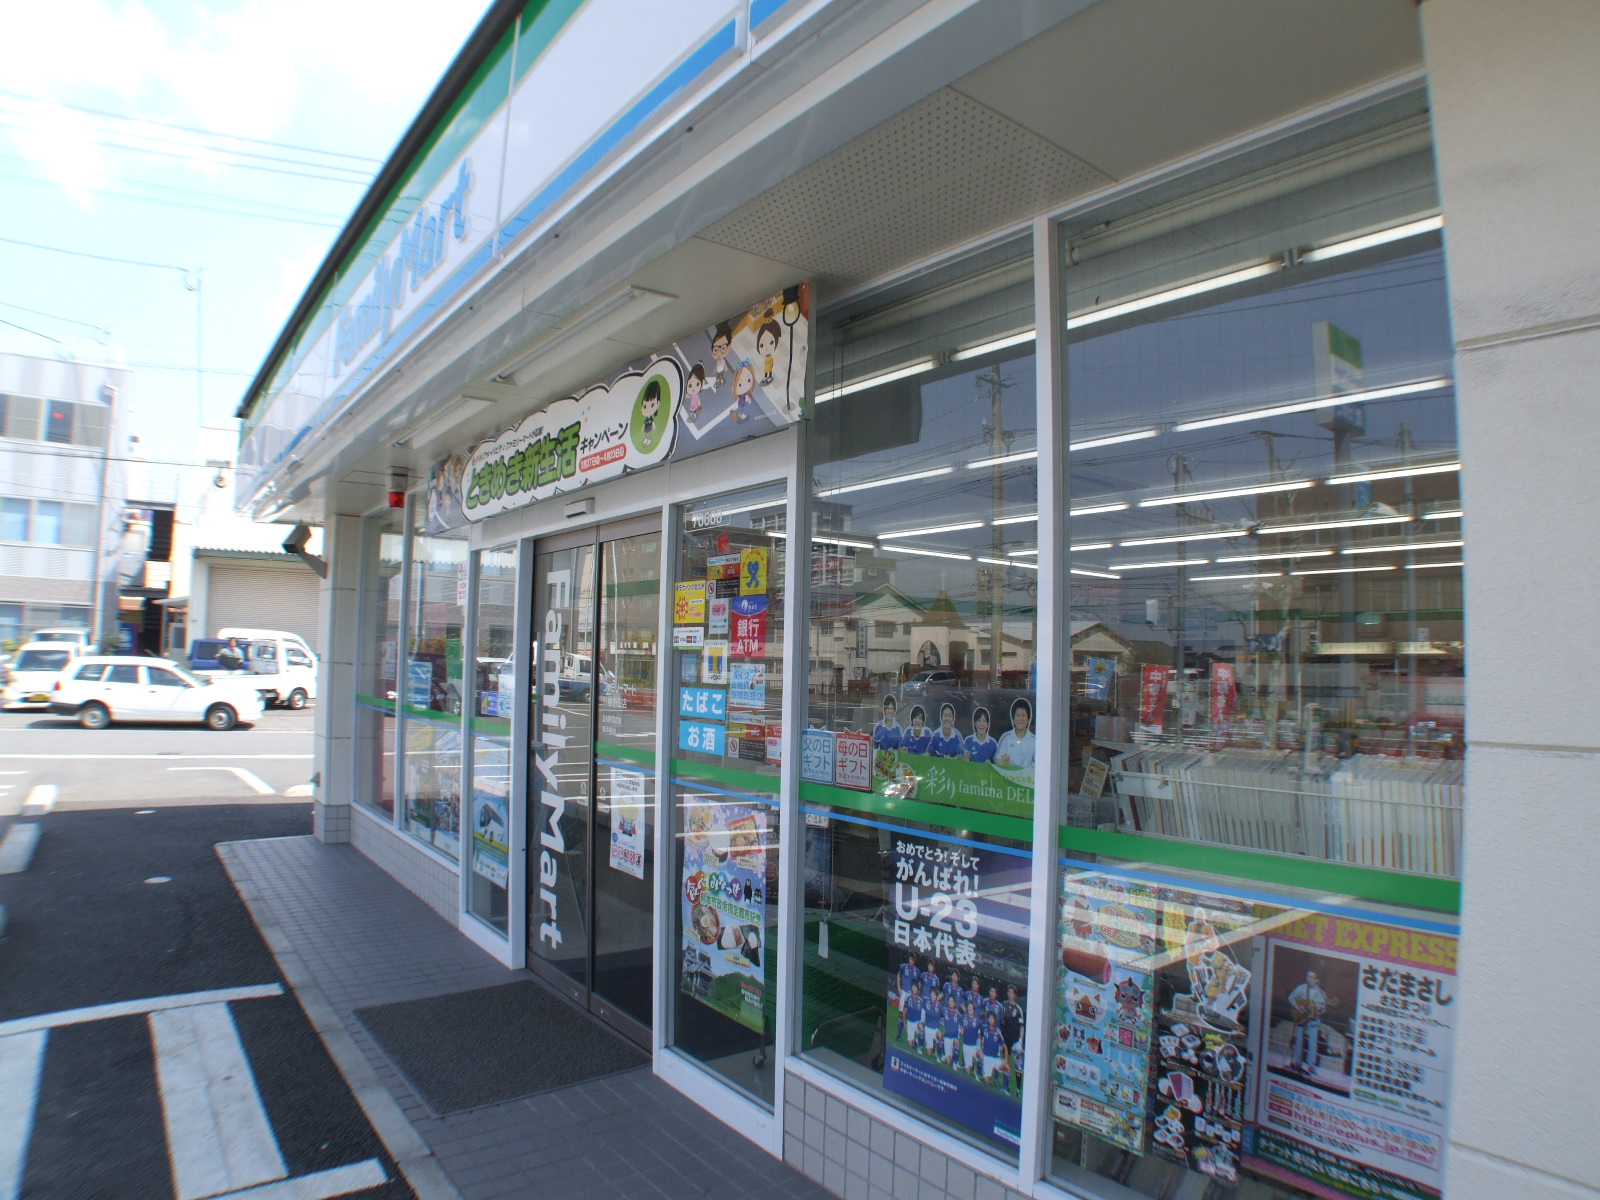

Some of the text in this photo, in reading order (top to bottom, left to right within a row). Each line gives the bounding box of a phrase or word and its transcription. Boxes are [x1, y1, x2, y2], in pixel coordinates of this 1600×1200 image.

[333, 157, 472, 378] FamilyMart
[580, 422, 629, 454] キャンペーン
[466, 420, 582, 510] ときめき新生活
[737, 618, 760, 638] 銀行
[736, 638, 759, 653] ATM
[682, 690, 723, 715] たばこ
[687, 726, 716, 752] お酒
[803, 737, 831, 754] 父の日
[837, 740, 868, 758] 母の日
[536, 569, 571, 950] FamilyMart
[803, 753, 830, 770] ギフト
[838, 757, 867, 775] ギフト
[924, 765, 957, 800] 彩り
[958, 779, 1003, 799] famima
[896, 856, 980, 898] がんばれ!
[895, 881, 978, 939] U-23
[894, 919, 977, 969] 日本代表
[1362, 964, 1453, 1006] さだまさし
[1379, 993, 1431, 1015] さだまつり
